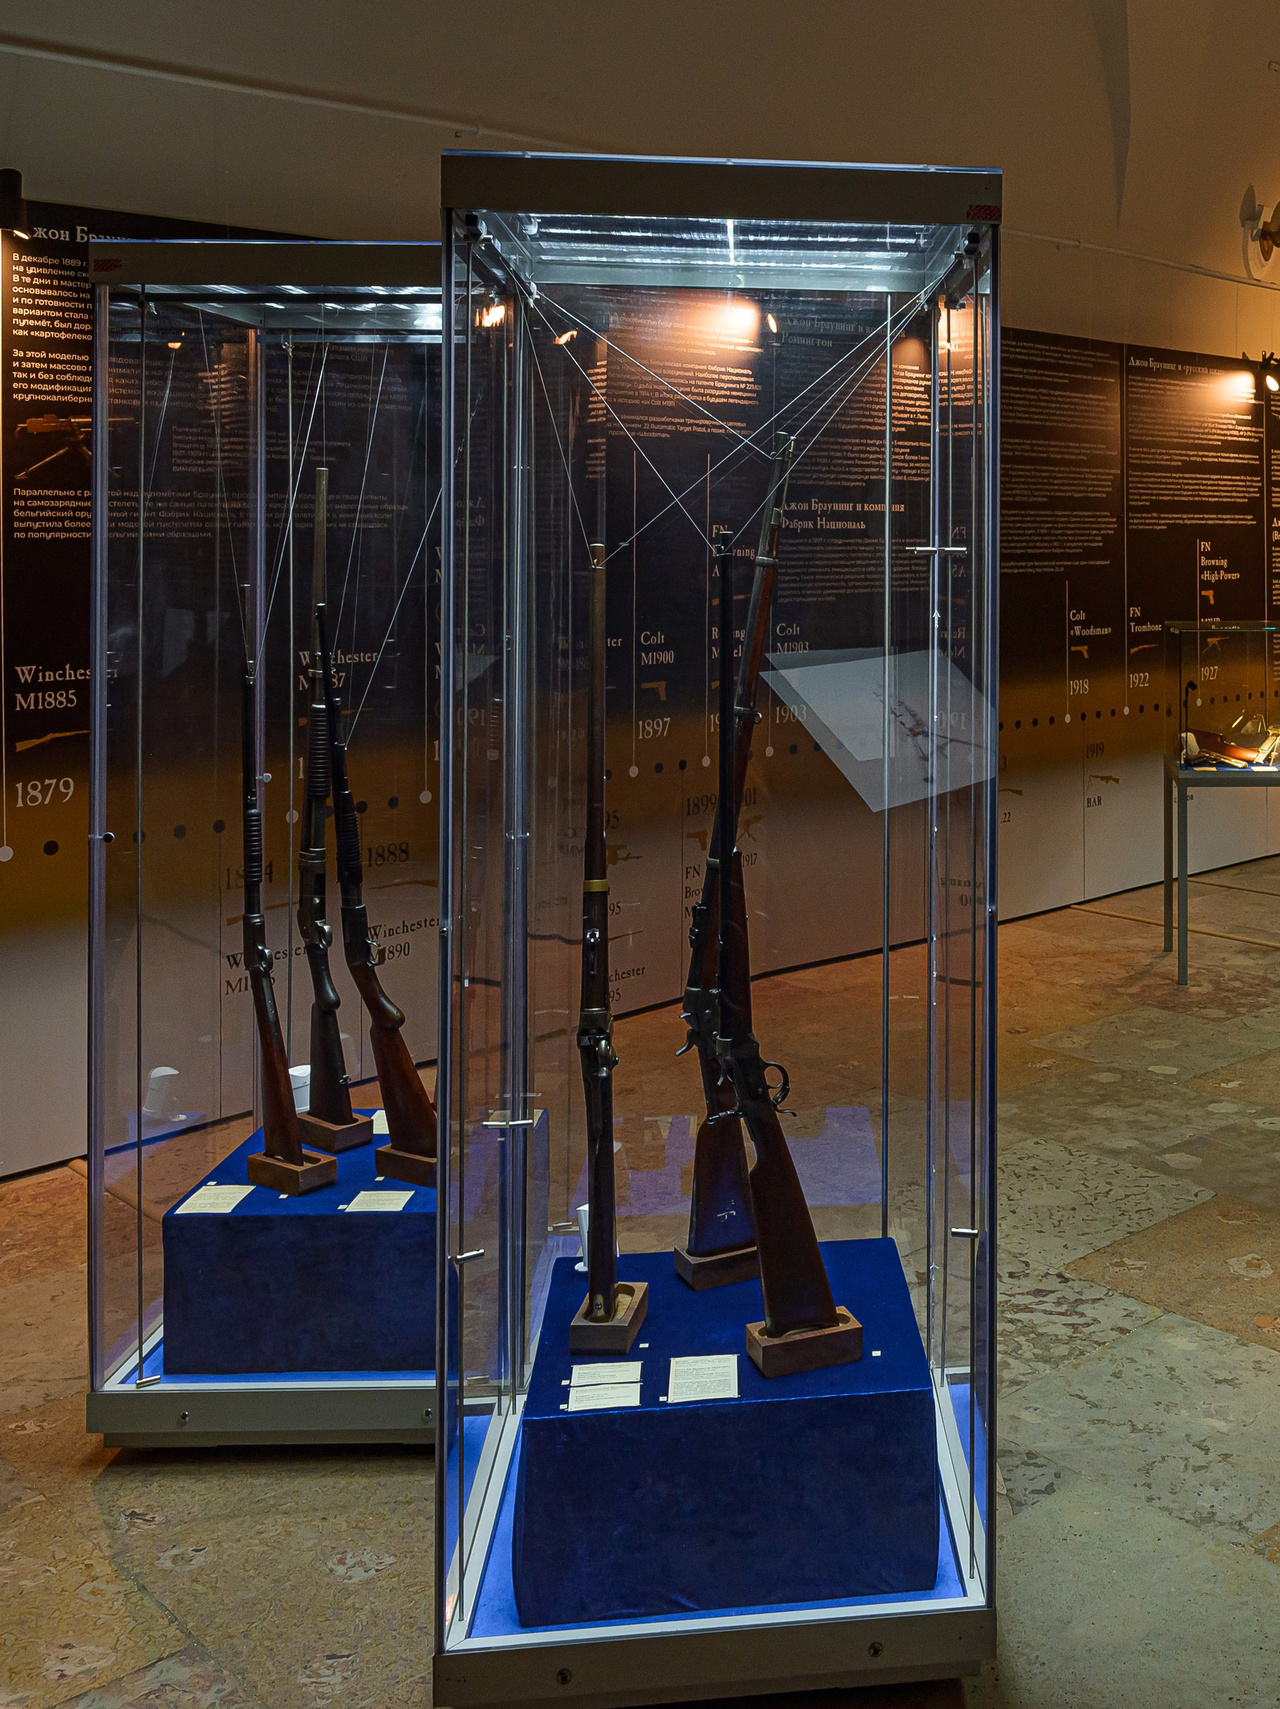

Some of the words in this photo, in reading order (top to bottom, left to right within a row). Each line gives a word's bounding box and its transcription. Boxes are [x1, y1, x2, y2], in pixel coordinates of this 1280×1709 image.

[14, 226, 70, 242] жон
[12, 253, 19, 261] В
[21, 255, 60, 266] декабре
[62, 258, 82, 267] 1889
[26, 266, 76, 277] удивление
[12, 275, 19, 283] В
[33, 277, 51, 285] дни
[60, 281, 92, 290] мастер
[12, 286, 78, 300] основывалось
[79, 292, 90, 300] на
[21, 298, 33, 306] по
[35, 300, 85, 311] готовности
[12, 307, 63, 319] вариантом
[65, 311, 89, 320] стала
[54, 319, 72, 329] был
[12, 328, 29, 336] как
[30, 330, 92, 341] «картофелеко
[12, 349, 24, 357] За
[25, 350, 47, 359] этой
[48, 352, 89, 362] моделью
[21, 362, 47, 370] затем
[49, 364, 87, 372] массово
[1128, 356, 1148, 368] Джон
[1149, 358, 1176, 373] Браунинг
[12, 371, 28, 379] так
[38, 371, 54, 380] без
[12, 382, 28, 390] его
[13, 487, 75, 498] Параллельно
[13, 508, 73, 518] бельгийский
[810, 498, 853, 516] Браунинг
[856, 503, 862, 511] и
[863, 503, 905, 514] компния
[13, 520, 62, 530] выпустила
[817, 516, 866, 530] Националь
[27, 531, 92, 541] популярности
[1200, 541, 1212, 552] FN
[1200, 556, 1228, 569] Browning
[1070, 609, 1086, 622] Colt
[1129, 606, 1142, 618] FN
[776, 622, 801, 638] Colt
[1070, 625, 1112, 637] «Woodsman»
[1129, 621, 1162, 634] Trombone
[640, 631, 665, 646] Colt
[776, 640, 810, 656] M1903
[298, 649, 379, 667] Wchester
[640, 649, 675, 667] M1900
[1200, 665, 1219, 682] 1927
[1070, 678, 1089, 697] 1918
[1129, 672, 1150, 690] 1922
[15, 690, 77, 711] M1885
[775, 703, 808, 726] 1903
[637, 717, 672, 741] 1897
[1085, 742, 1105, 760] 1919
[15, 777, 75, 808] 1879
[1086, 795, 1103, 809] BAR
[366, 841, 410, 868] 1888
[225, 861, 273, 890] 184
[685, 863, 701, 881] FN
[368, 917, 440, 941] Winchester
[608, 963, 646, 983] chester
